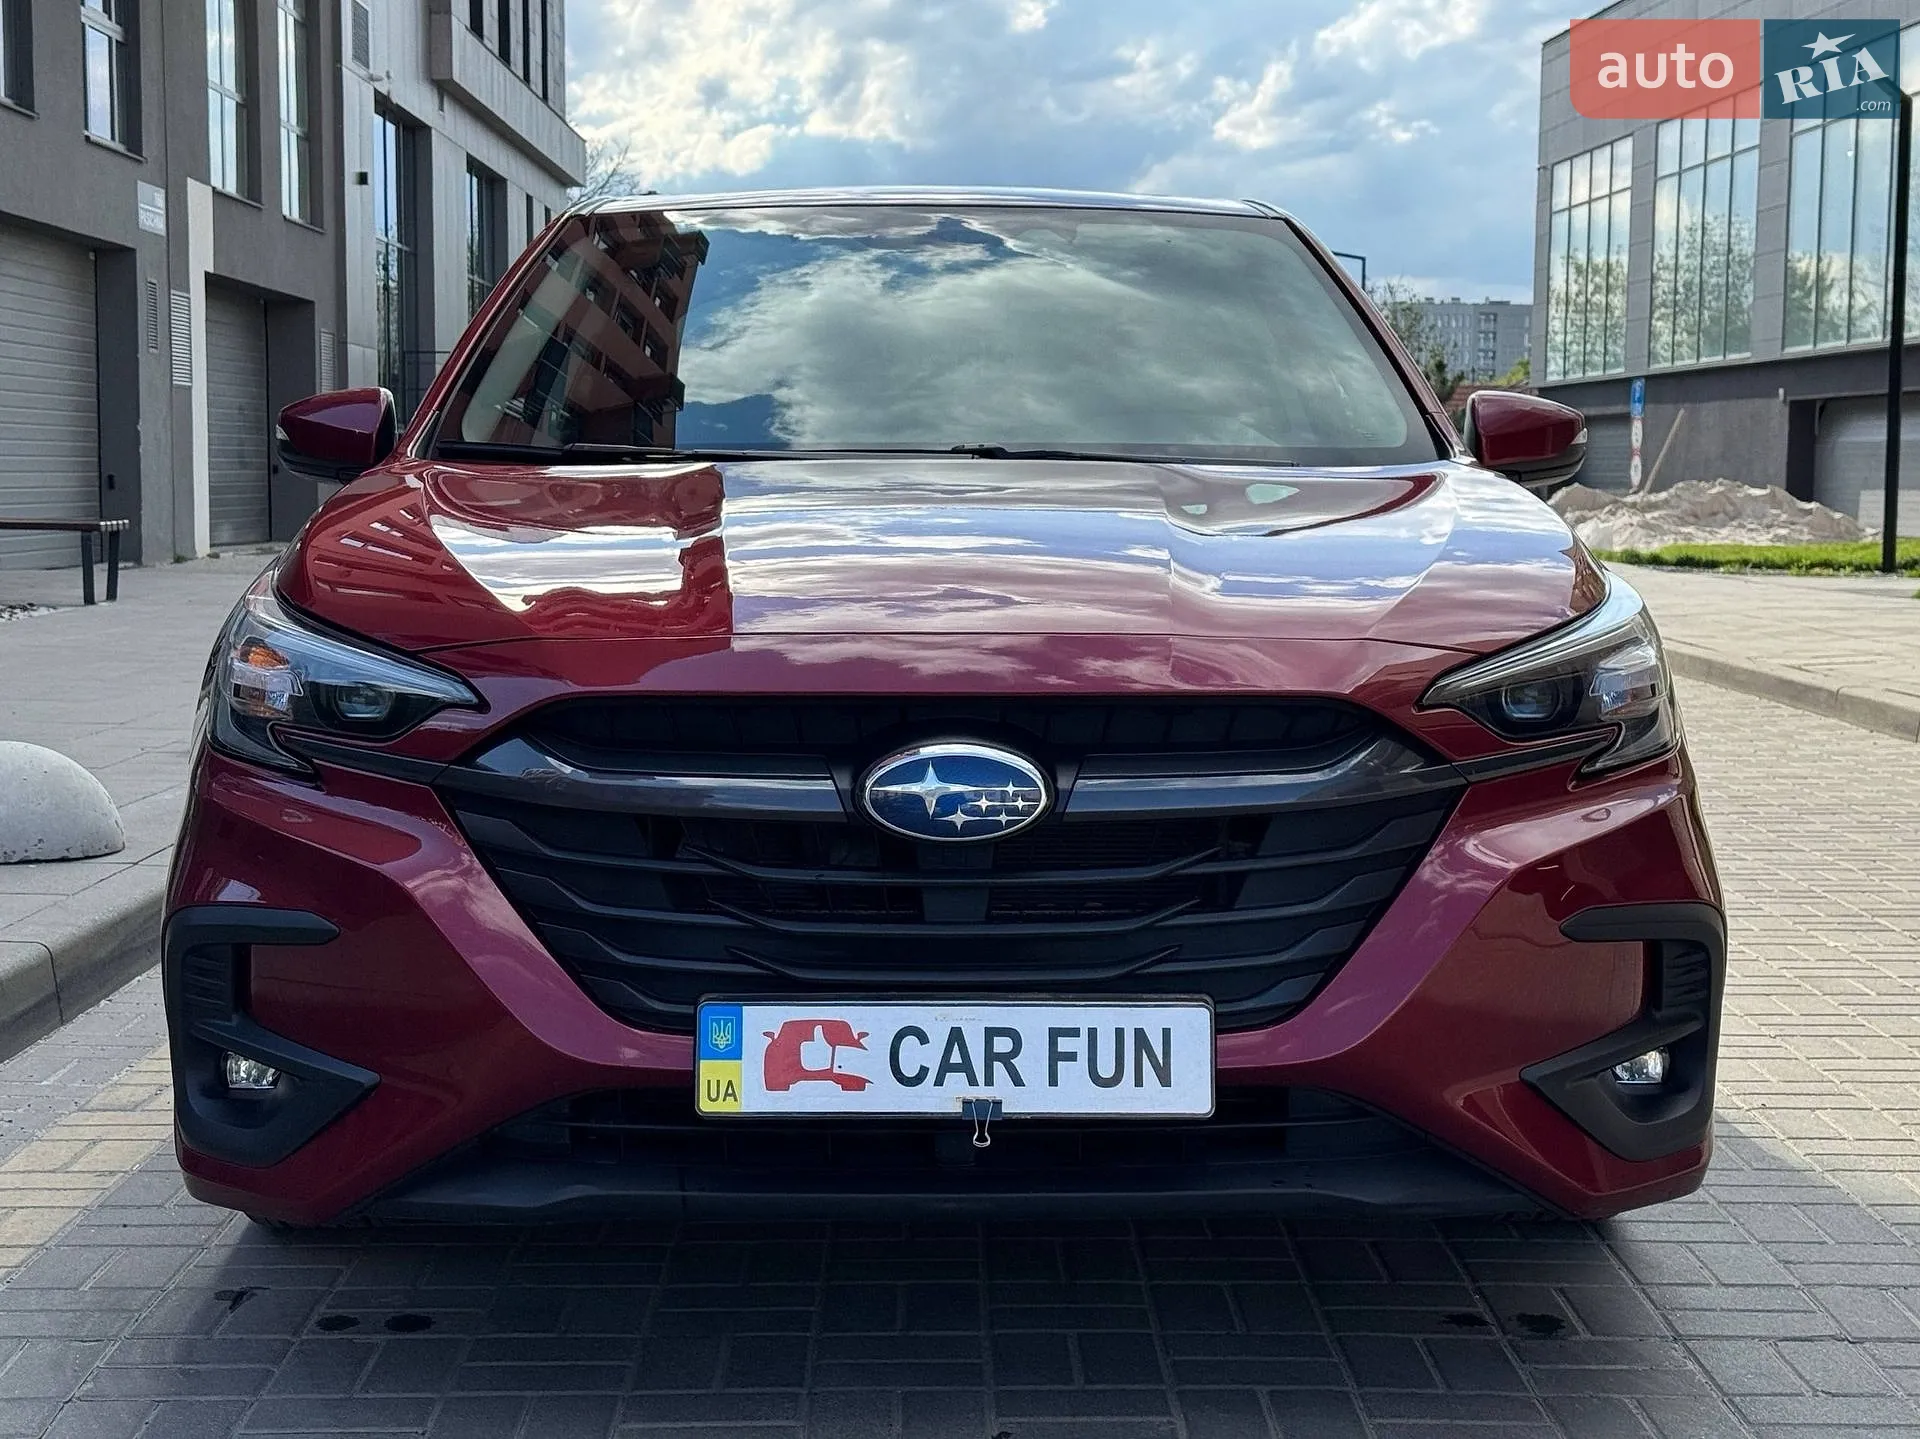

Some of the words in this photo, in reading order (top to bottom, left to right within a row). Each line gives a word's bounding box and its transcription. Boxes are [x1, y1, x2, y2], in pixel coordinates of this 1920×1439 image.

[889, 1025, 1026, 1088] CAR
[1048, 1027, 1172, 1088] FUN
[706, 1079, 738, 1103] UA
